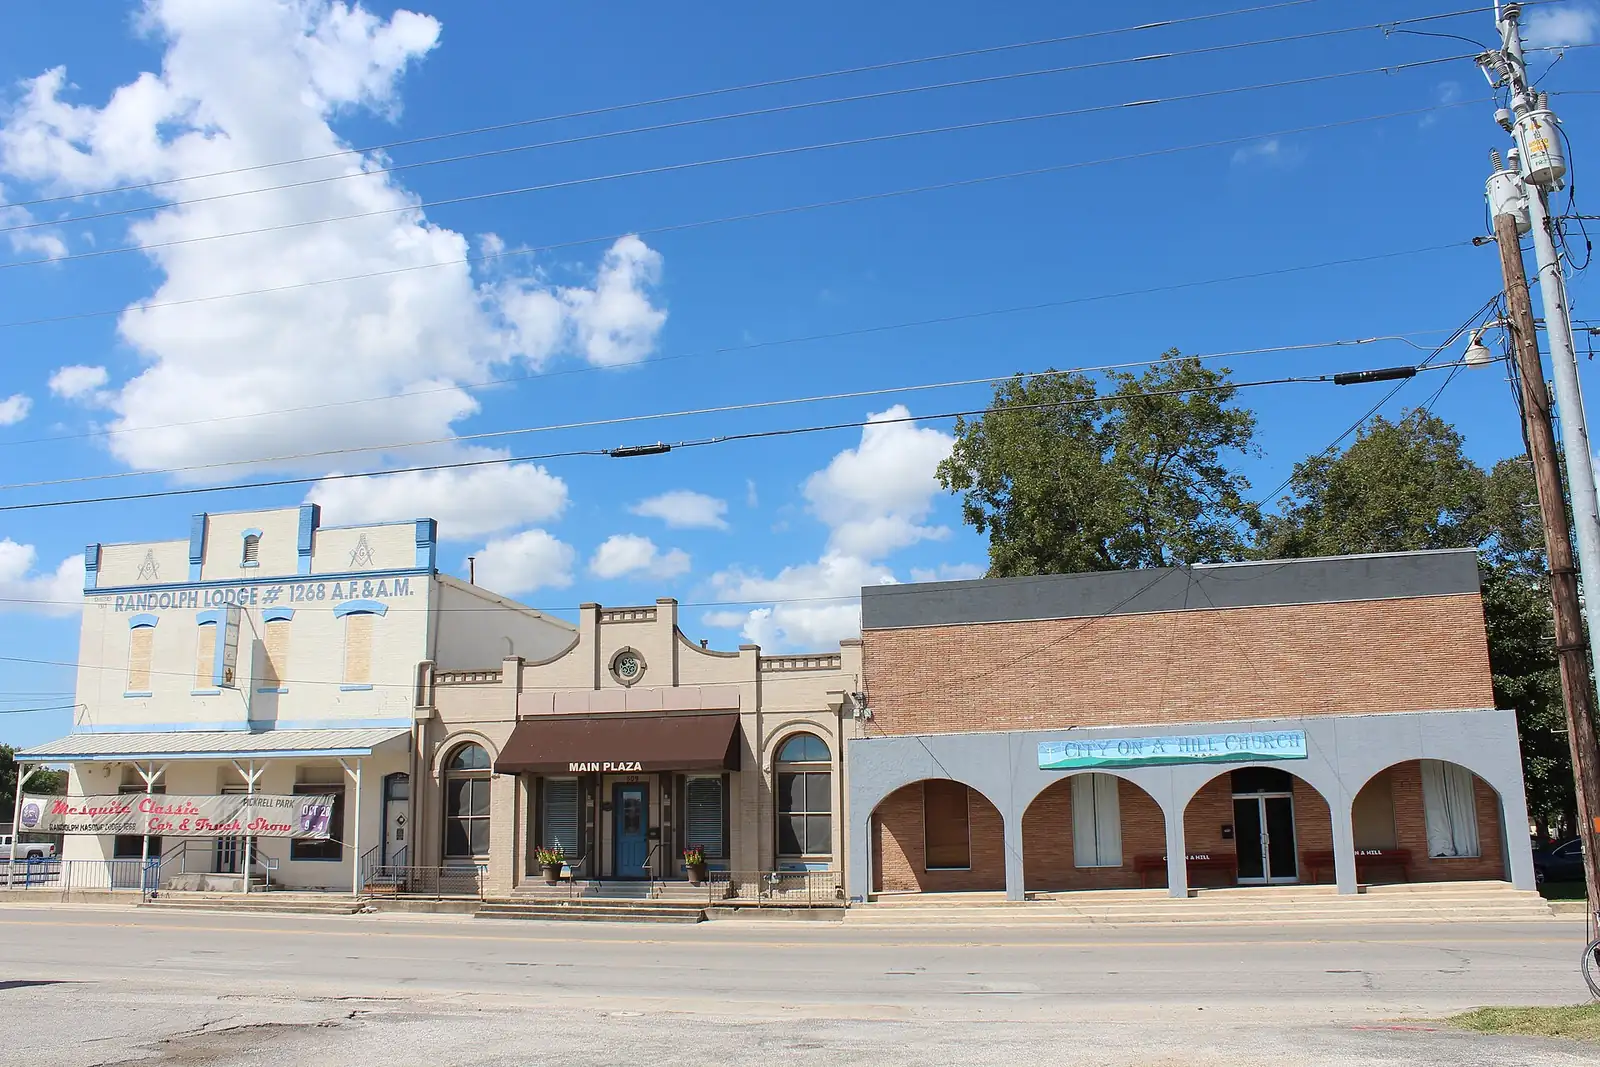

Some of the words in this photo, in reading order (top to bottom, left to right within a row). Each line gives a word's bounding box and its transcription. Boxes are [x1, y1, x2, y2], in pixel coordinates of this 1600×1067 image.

[115, 590, 198, 612] RANDOLPH
[204, 587, 258, 607] LODGE
[262, 585, 283, 604] #
[289, 583, 326, 602] 1268
[1065, 740, 1110, 757] CITY
[1118, 740, 1143, 755] ON
[1152, 739, 1165, 754] A
[1179, 736, 1218, 752] HILL
[1225, 734, 1301, 752] CHURCH
[569, 762, 599, 772] MAIN
[603, 761, 642, 771] PLAZA
[51, 799, 132, 817] Mesquite
[139, 798, 200, 815] Classic
[276, 799, 294, 808] PARK
[302, 804, 318, 816] OCT
[49, 823, 79, 832] RANDOLPH
[148, 817, 173, 831] Car
[179, 818, 190, 831] &
[195, 818, 241, 831] Truck
[247, 817, 292, 831] Show
